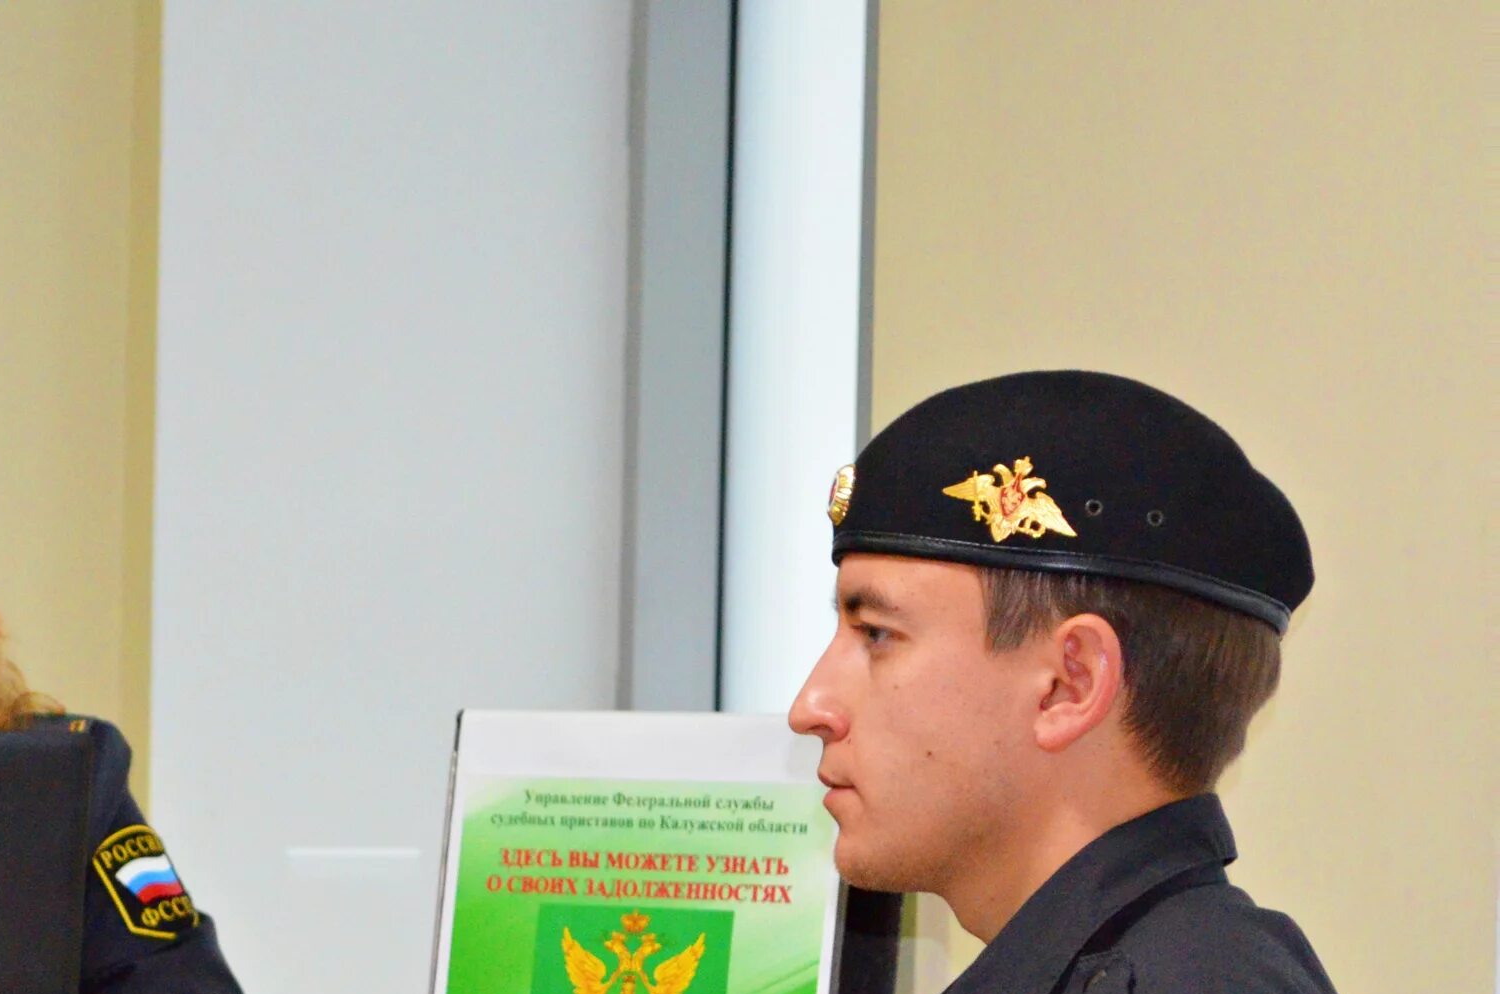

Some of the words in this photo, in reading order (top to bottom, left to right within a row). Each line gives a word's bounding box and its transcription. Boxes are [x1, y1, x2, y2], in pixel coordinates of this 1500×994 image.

[524, 789, 610, 807] Управление
[613, 791, 711, 811] Федеральной
[715, 796, 775, 813] службы
[490, 812, 556, 829] судебных
[560, 815, 634, 830] приставов
[638, 818, 656, 829] по
[659, 815, 745, 834] Калужской
[748, 818, 808, 834] области
[500, 848, 563, 868] ЗДЕСЬ
[568, 850, 600, 869] ВЫ
[606, 851, 699, 873] МОЖЕТЕ
[705, 854, 790, 875] УЗНАТЬ
[486, 874, 502, 893] О
[506, 875, 579, 896] СВОИХ
[584, 878, 793, 904] ЗАДОЛЖЕННОСТЯХ
